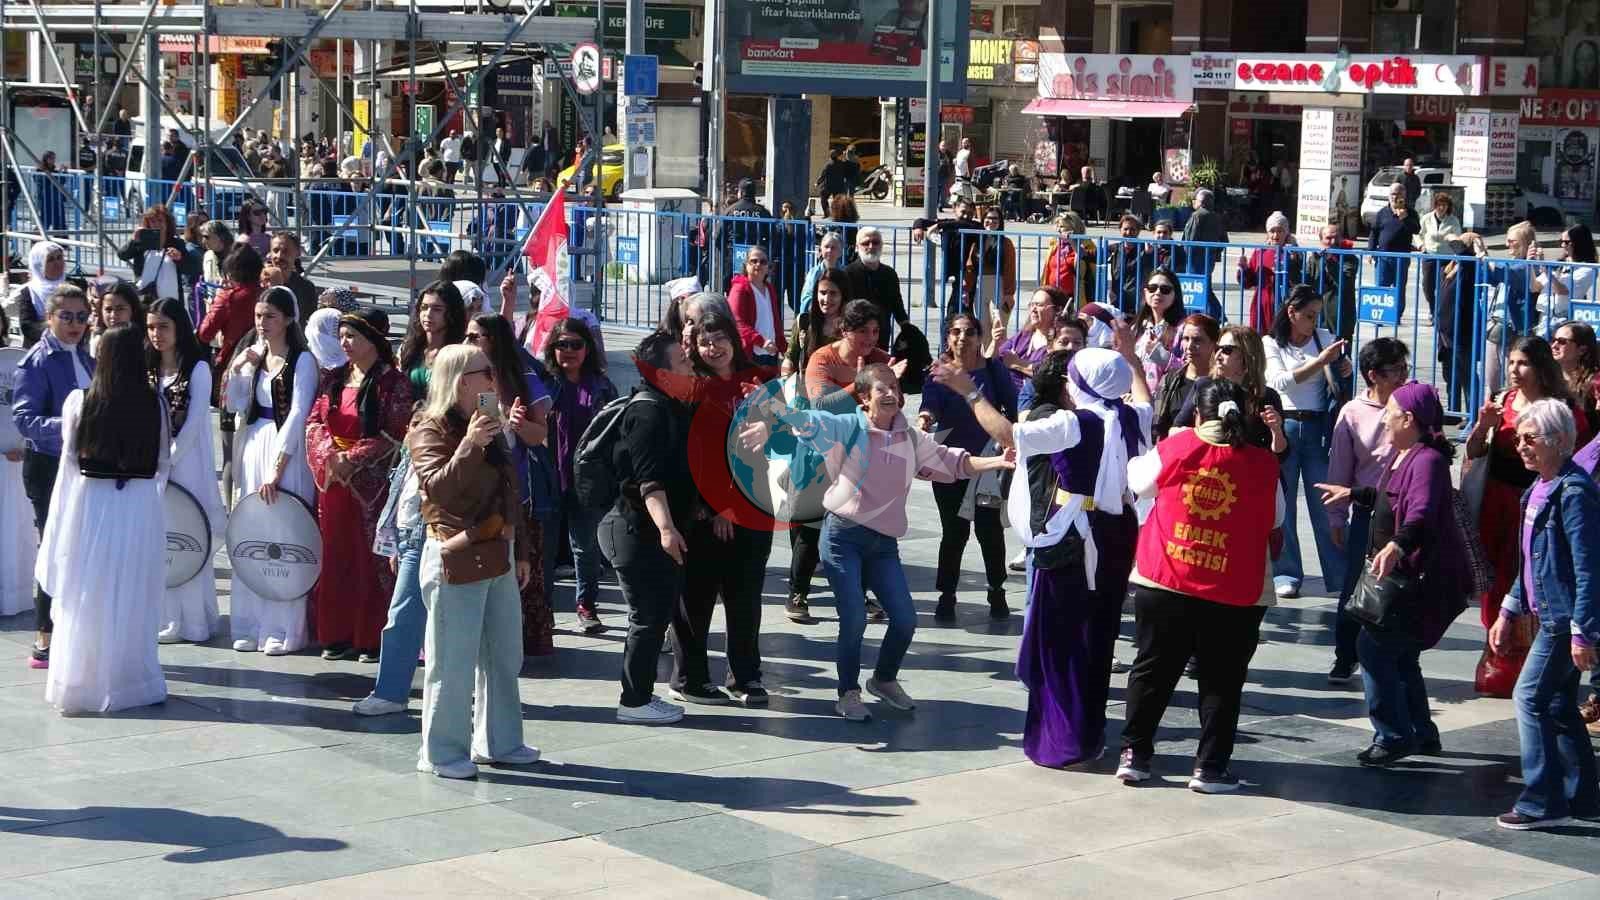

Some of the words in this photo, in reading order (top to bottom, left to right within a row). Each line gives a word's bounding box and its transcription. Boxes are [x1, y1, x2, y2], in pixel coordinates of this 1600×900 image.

[761, 6, 783, 17] iftar
[969, 40, 1013, 64] MONEY
[1053, 56, 1099, 98] mis
[1106, 56, 1176, 99] simit
[1237, 62, 1325, 83] eczane
[1348, 56, 1419, 90] optik
[1183, 294, 1195, 305] 07
[1362, 293, 1395, 307] POLİS
[1371, 309, 1385, 321] 07
[1174, 521, 1230, 550] EMEK
[1166, 540, 1229, 573] PARTİSİ
